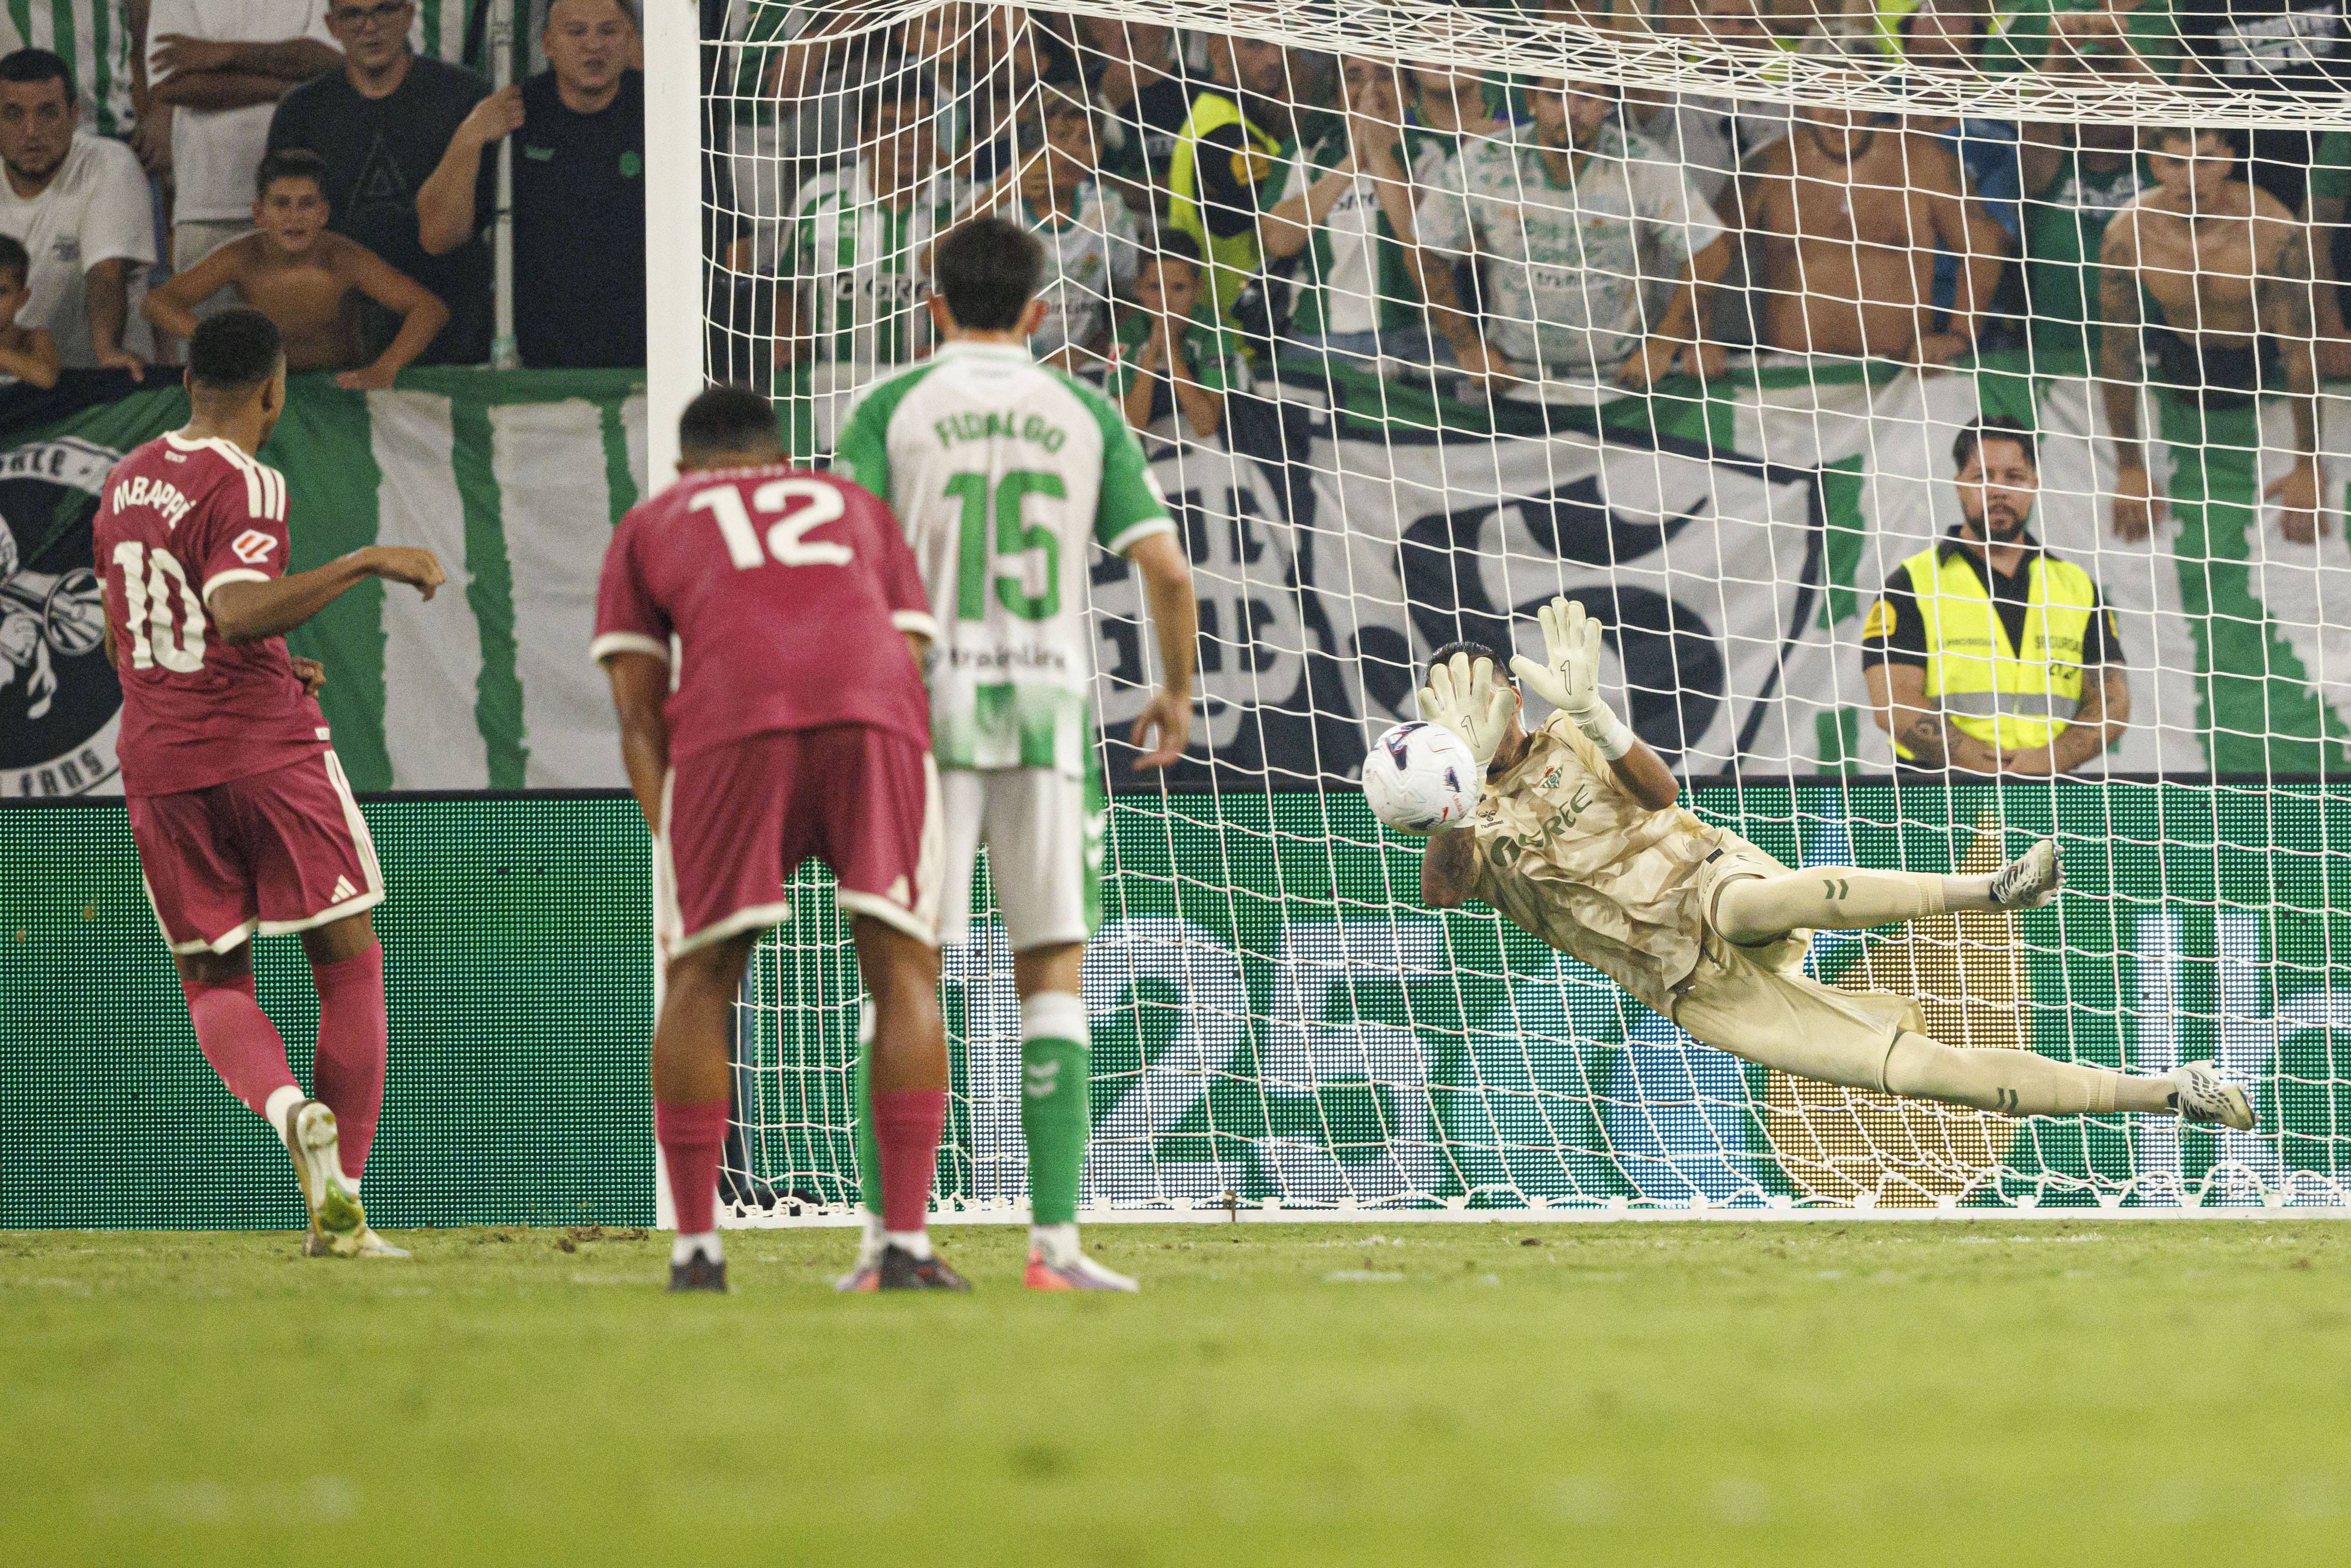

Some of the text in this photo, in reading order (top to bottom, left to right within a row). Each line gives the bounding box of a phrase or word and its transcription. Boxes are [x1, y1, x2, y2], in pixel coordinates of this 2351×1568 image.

[933, 408, 1067, 454] FIDALGO
[688, 478, 855, 572] 12
[943, 470, 1069, 624] 15
[113, 540, 207, 673] 10
[1481, 819, 1504, 829] hummel
[942, 918, 1440, 1209] 125
